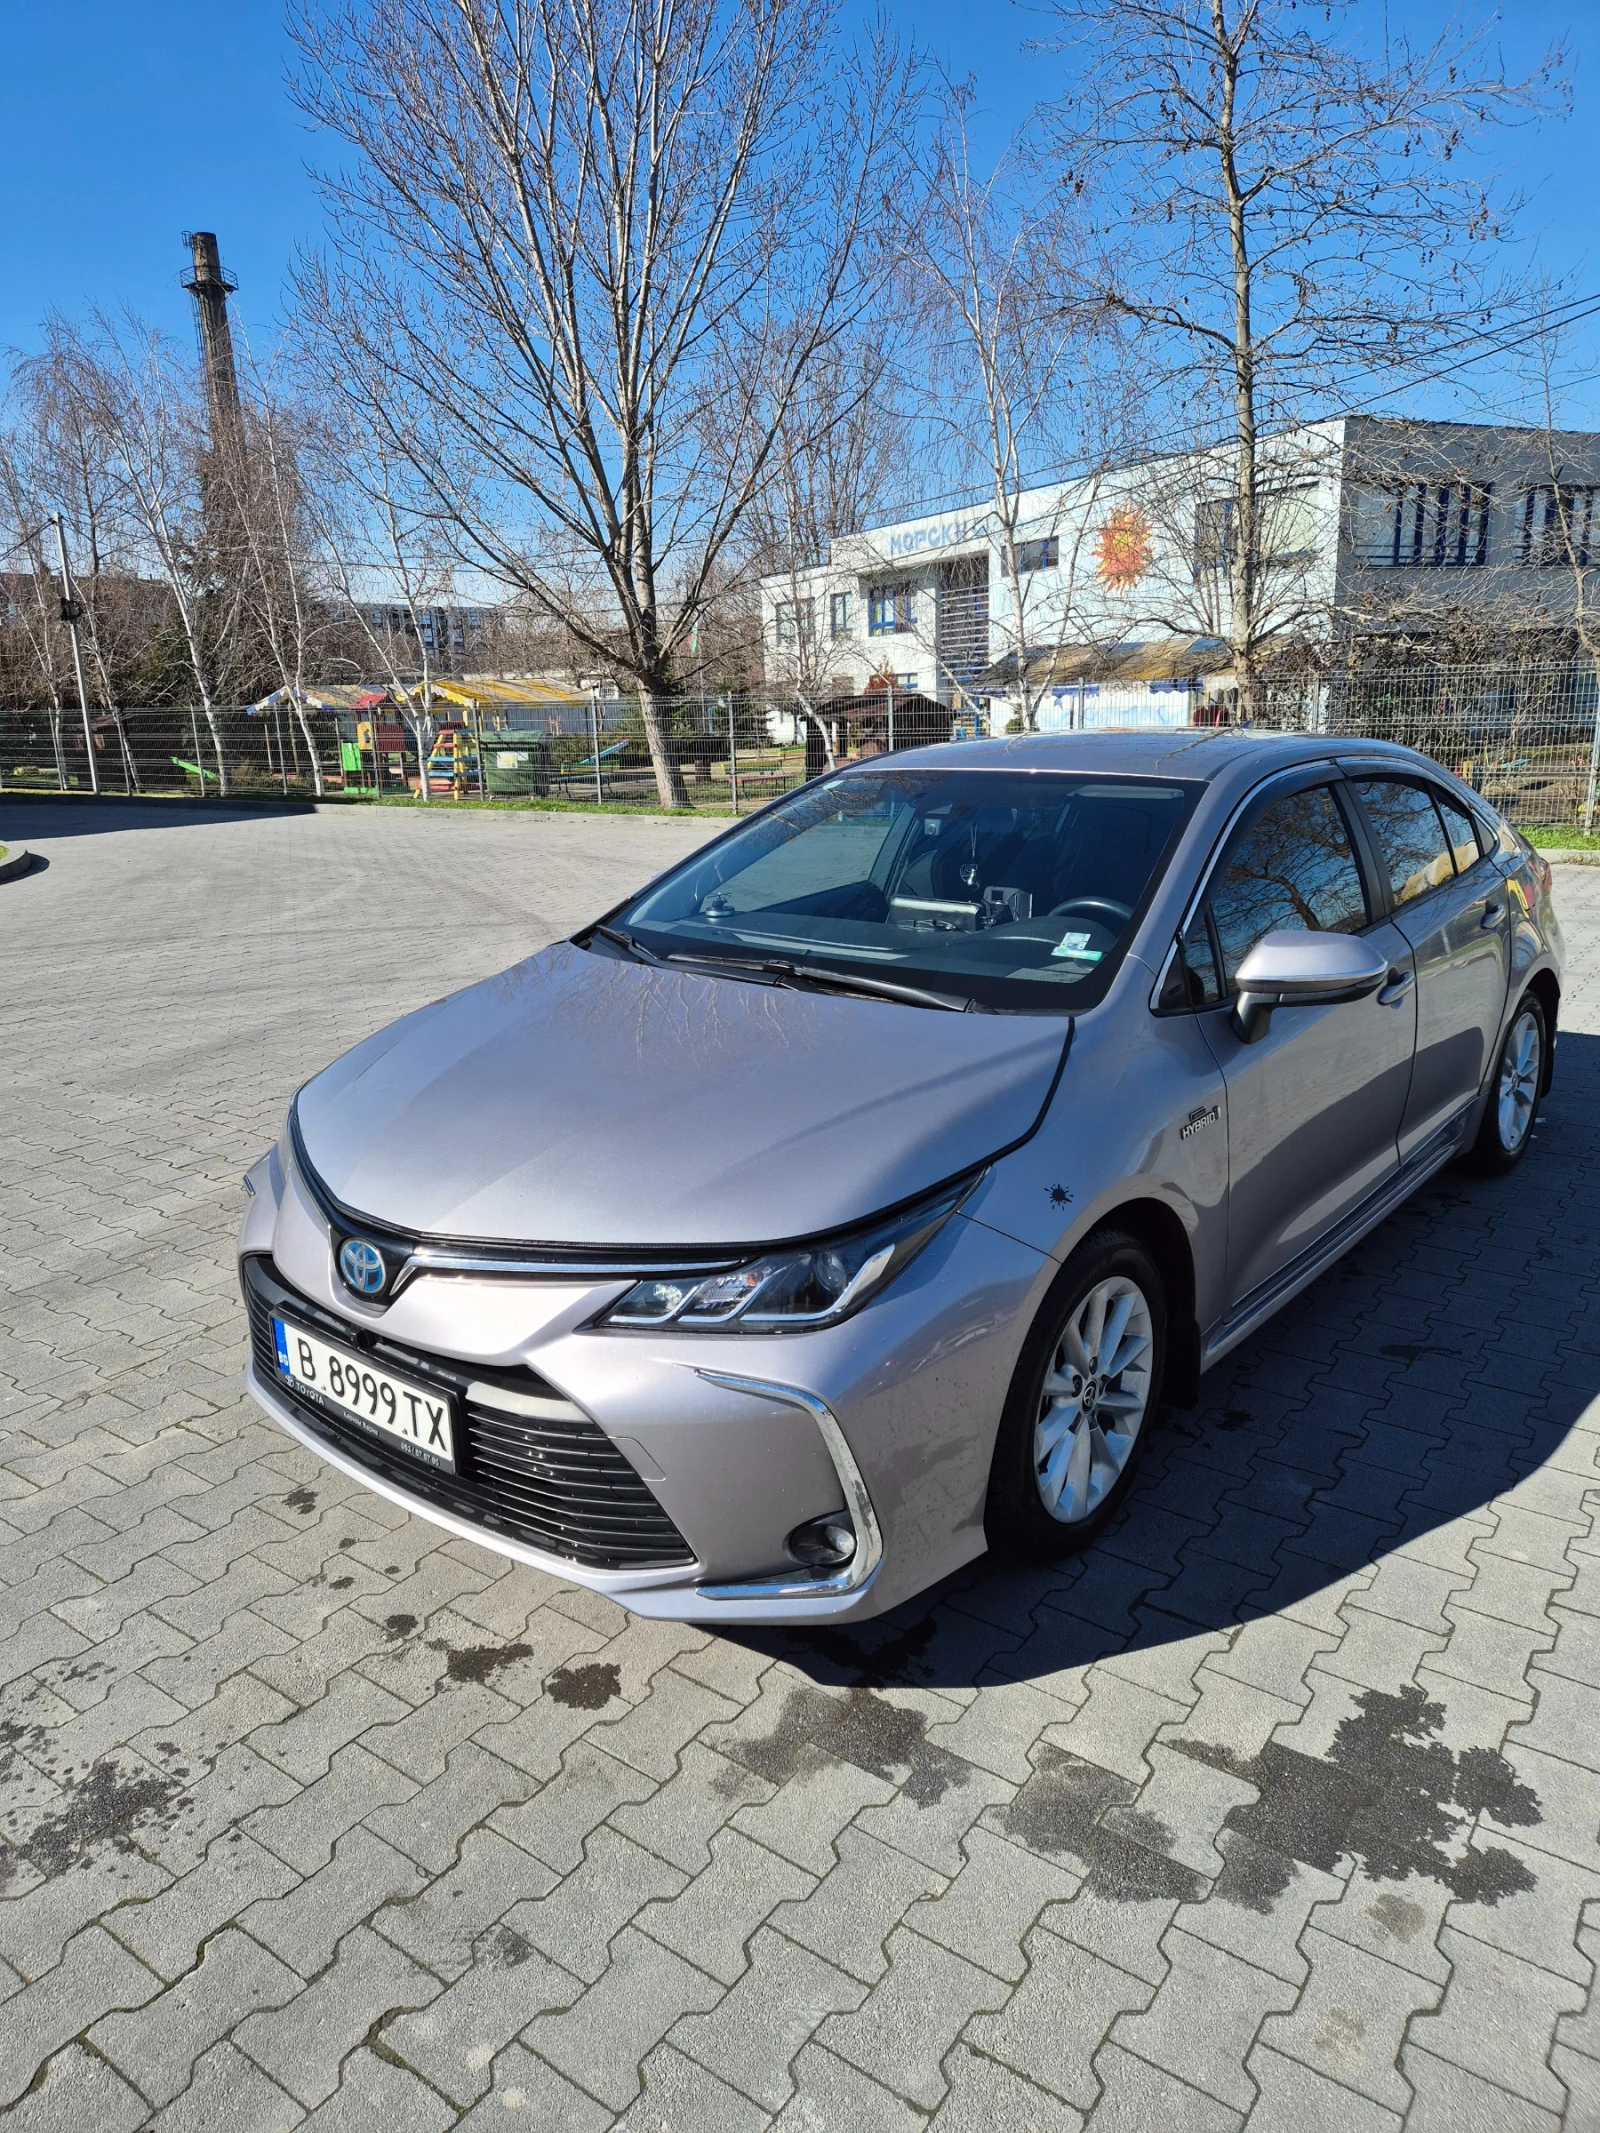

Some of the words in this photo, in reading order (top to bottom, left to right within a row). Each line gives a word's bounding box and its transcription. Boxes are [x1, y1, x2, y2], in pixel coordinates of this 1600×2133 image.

[1180, 1111, 1216, 1140] HYBRID
[278, 1350, 289, 1367] BG
[295, 1381, 325, 1406] TOYOTA
[297, 1337, 316, 1381] B
[328, 1355, 397, 1425] 8999
[403, 1390, 448, 1452] TX
